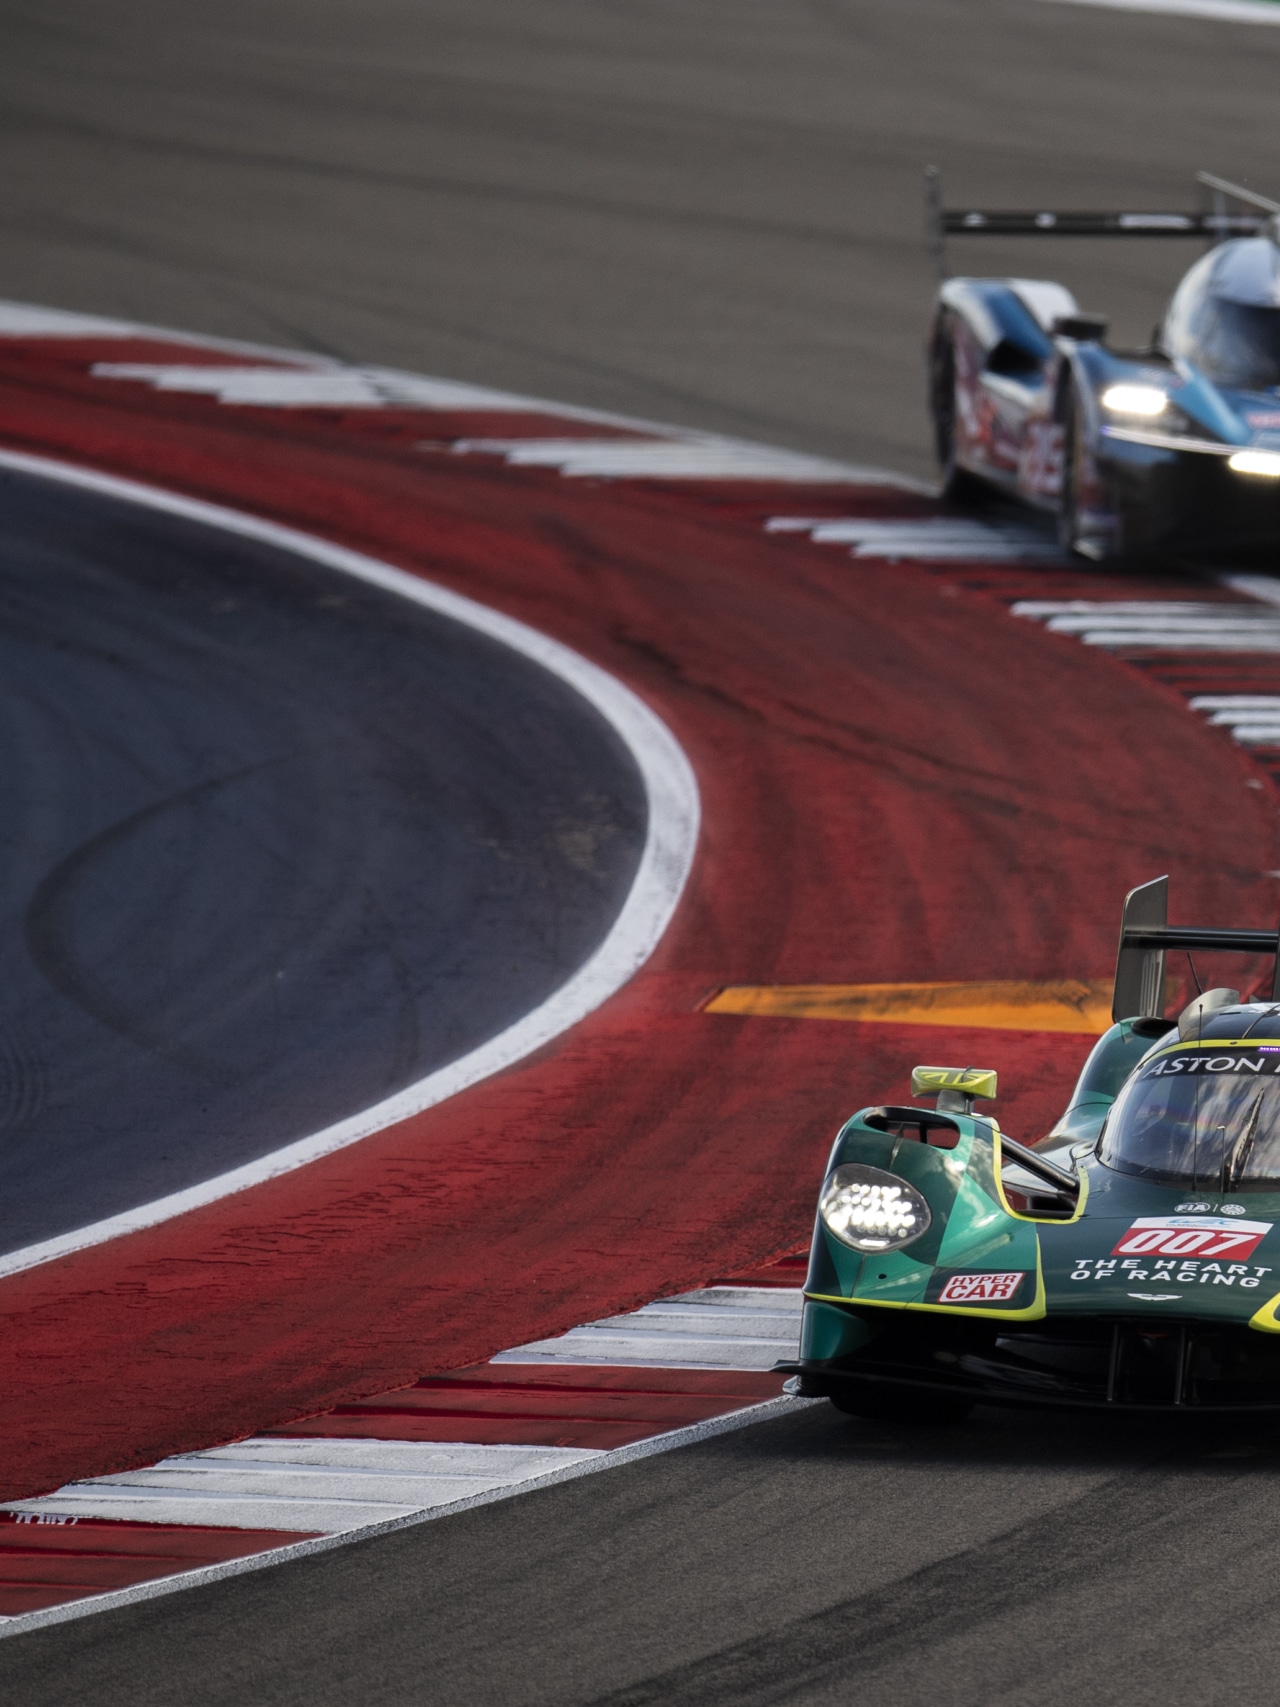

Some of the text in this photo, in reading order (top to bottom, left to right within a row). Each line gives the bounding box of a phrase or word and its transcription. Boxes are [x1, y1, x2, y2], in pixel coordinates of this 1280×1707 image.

[1147, 1057, 1265, 1076] ASTON
[1176, 1203, 1207, 1213] FIA
[1118, 1230, 1258, 1256] 007
[1075, 1259, 1273, 1277] THE HEART
[952, 1275, 1016, 1285] HYPER
[1070, 1270, 1261, 1288] OF RACING
[946, 1284, 1011, 1298] CAR
